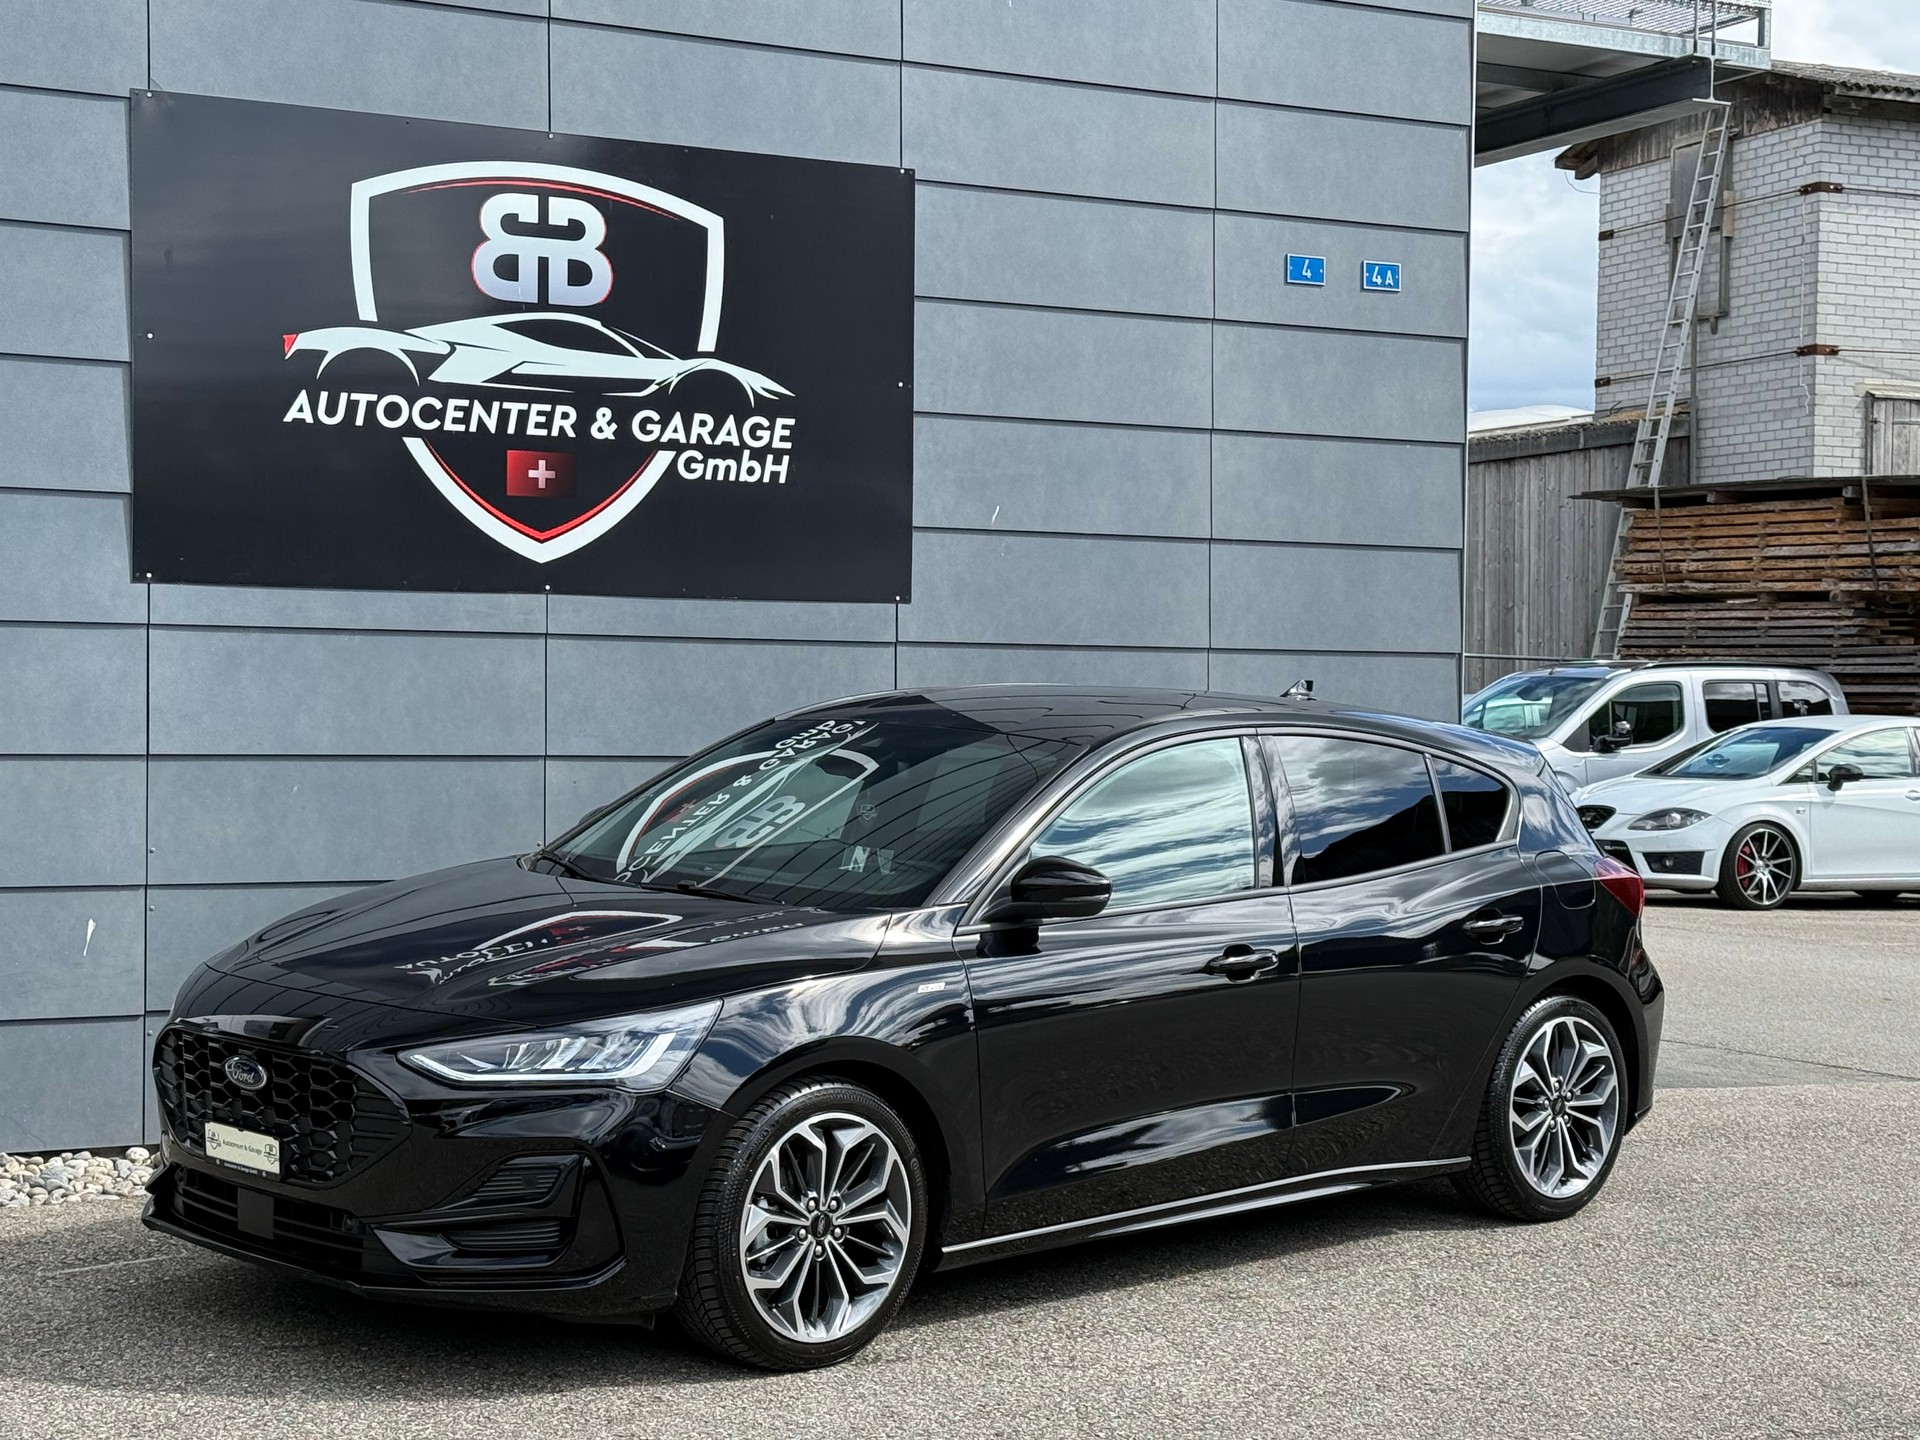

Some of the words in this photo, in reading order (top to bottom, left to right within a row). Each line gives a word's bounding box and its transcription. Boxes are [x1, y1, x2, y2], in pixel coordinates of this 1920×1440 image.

[1301, 259, 1312, 279] 4
[1371, 265, 1395, 286] 4A
[282, 389, 578, 440] AUTOCENTER
[591, 408, 618, 440] &
[631, 409, 796, 451] GARAGE
[676, 448, 790, 484] GmbH
[230, 1061, 256, 1084] Ford
